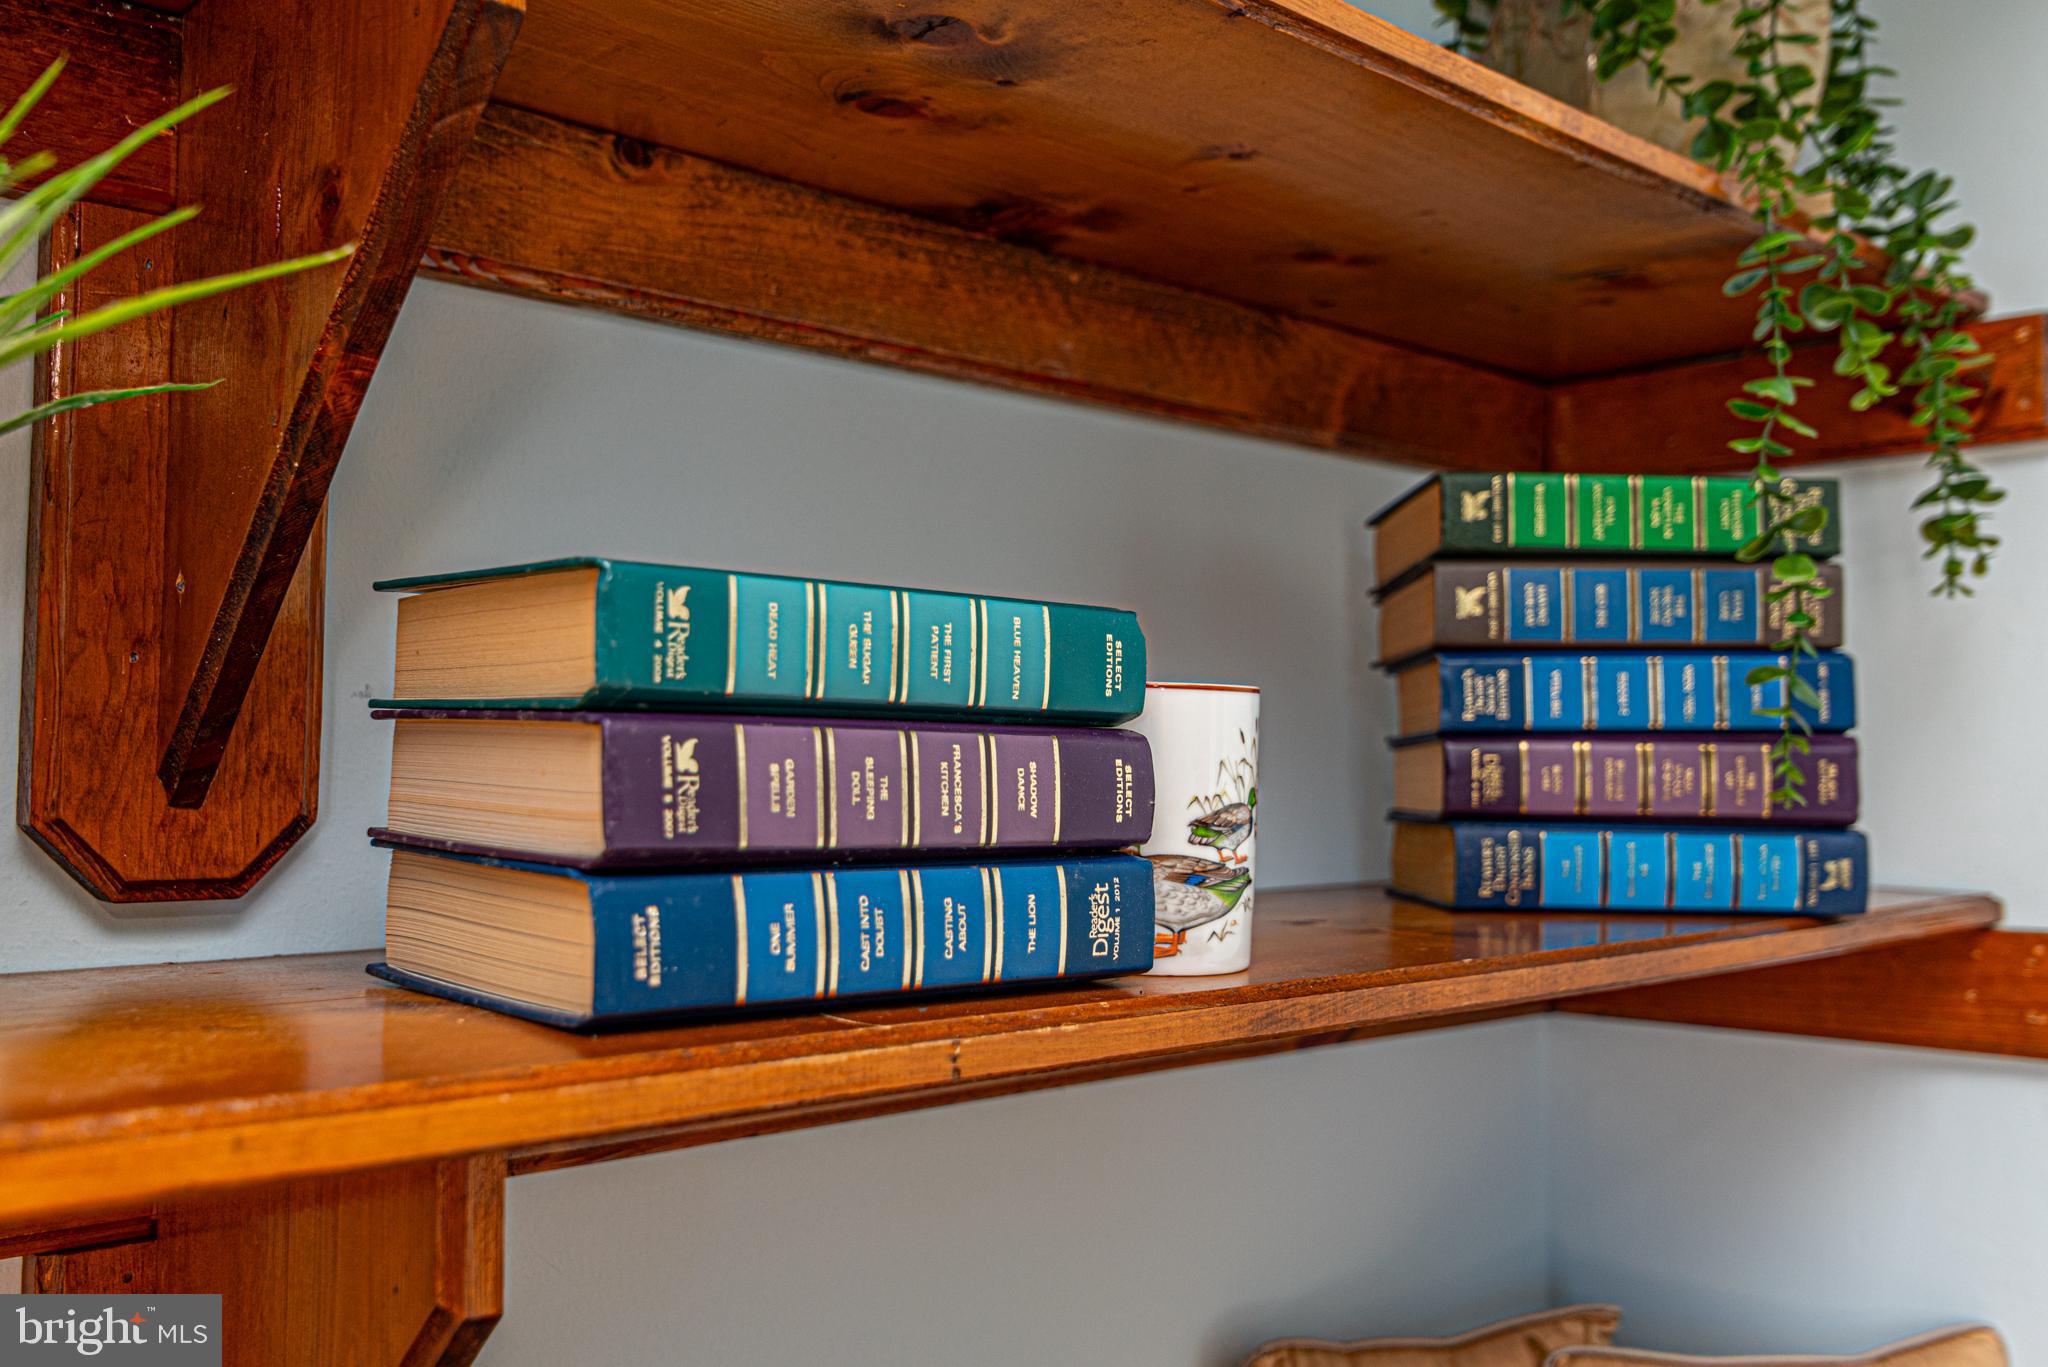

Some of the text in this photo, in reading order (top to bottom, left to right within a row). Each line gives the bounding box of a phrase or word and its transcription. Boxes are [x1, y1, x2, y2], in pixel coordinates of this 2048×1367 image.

[655, 582, 664, 633] VOLUME
[667, 622, 690, 679] Reader's
[767, 602, 778, 680] DEAD HEAT
[849, 624, 858, 669] QUEEN
[863, 611, 872, 685] THE SUGAR
[930, 626, 939, 680] PATIENT
[943, 623, 952, 684] THE FIRST
[1012, 616, 1021, 700] BLUE HEAVEN
[1105, 634, 1113, 697] EDITIONS
[661, 735, 673, 788] VOLUME
[770, 763, 781, 814] SPELLS
[785, 758, 796, 817] GARDEN
[851, 771, 861, 806] DOLL
[865, 756, 875, 820] SLEEPING
[880, 776, 888, 801] THE
[940, 761, 949, 817] KITCHEN
[952, 744, 961, 834] FRANCESCA'S
[1017, 768, 1026, 812] DANCE
[1029, 762, 1038, 819] SHADOW
[1115, 759, 1123, 823] EDITIONS
[677, 775, 700, 834] Reader's
[769, 922, 780, 956] ONE
[784, 903, 796, 973] SUMMER
[859, 895, 870, 972] CAST INTO
[875, 907, 885, 958] DOUBT
[944, 897, 953, 960] CASTING
[958, 903, 967, 951] ABOUT
[1027, 894, 1036, 953] THE LION
[1089, 893, 1098, 938] Reader's
[1092, 882, 1115, 957] Digest
[632, 914, 647, 981] SELECT
[645, 905, 661, 988] EDITIONS
